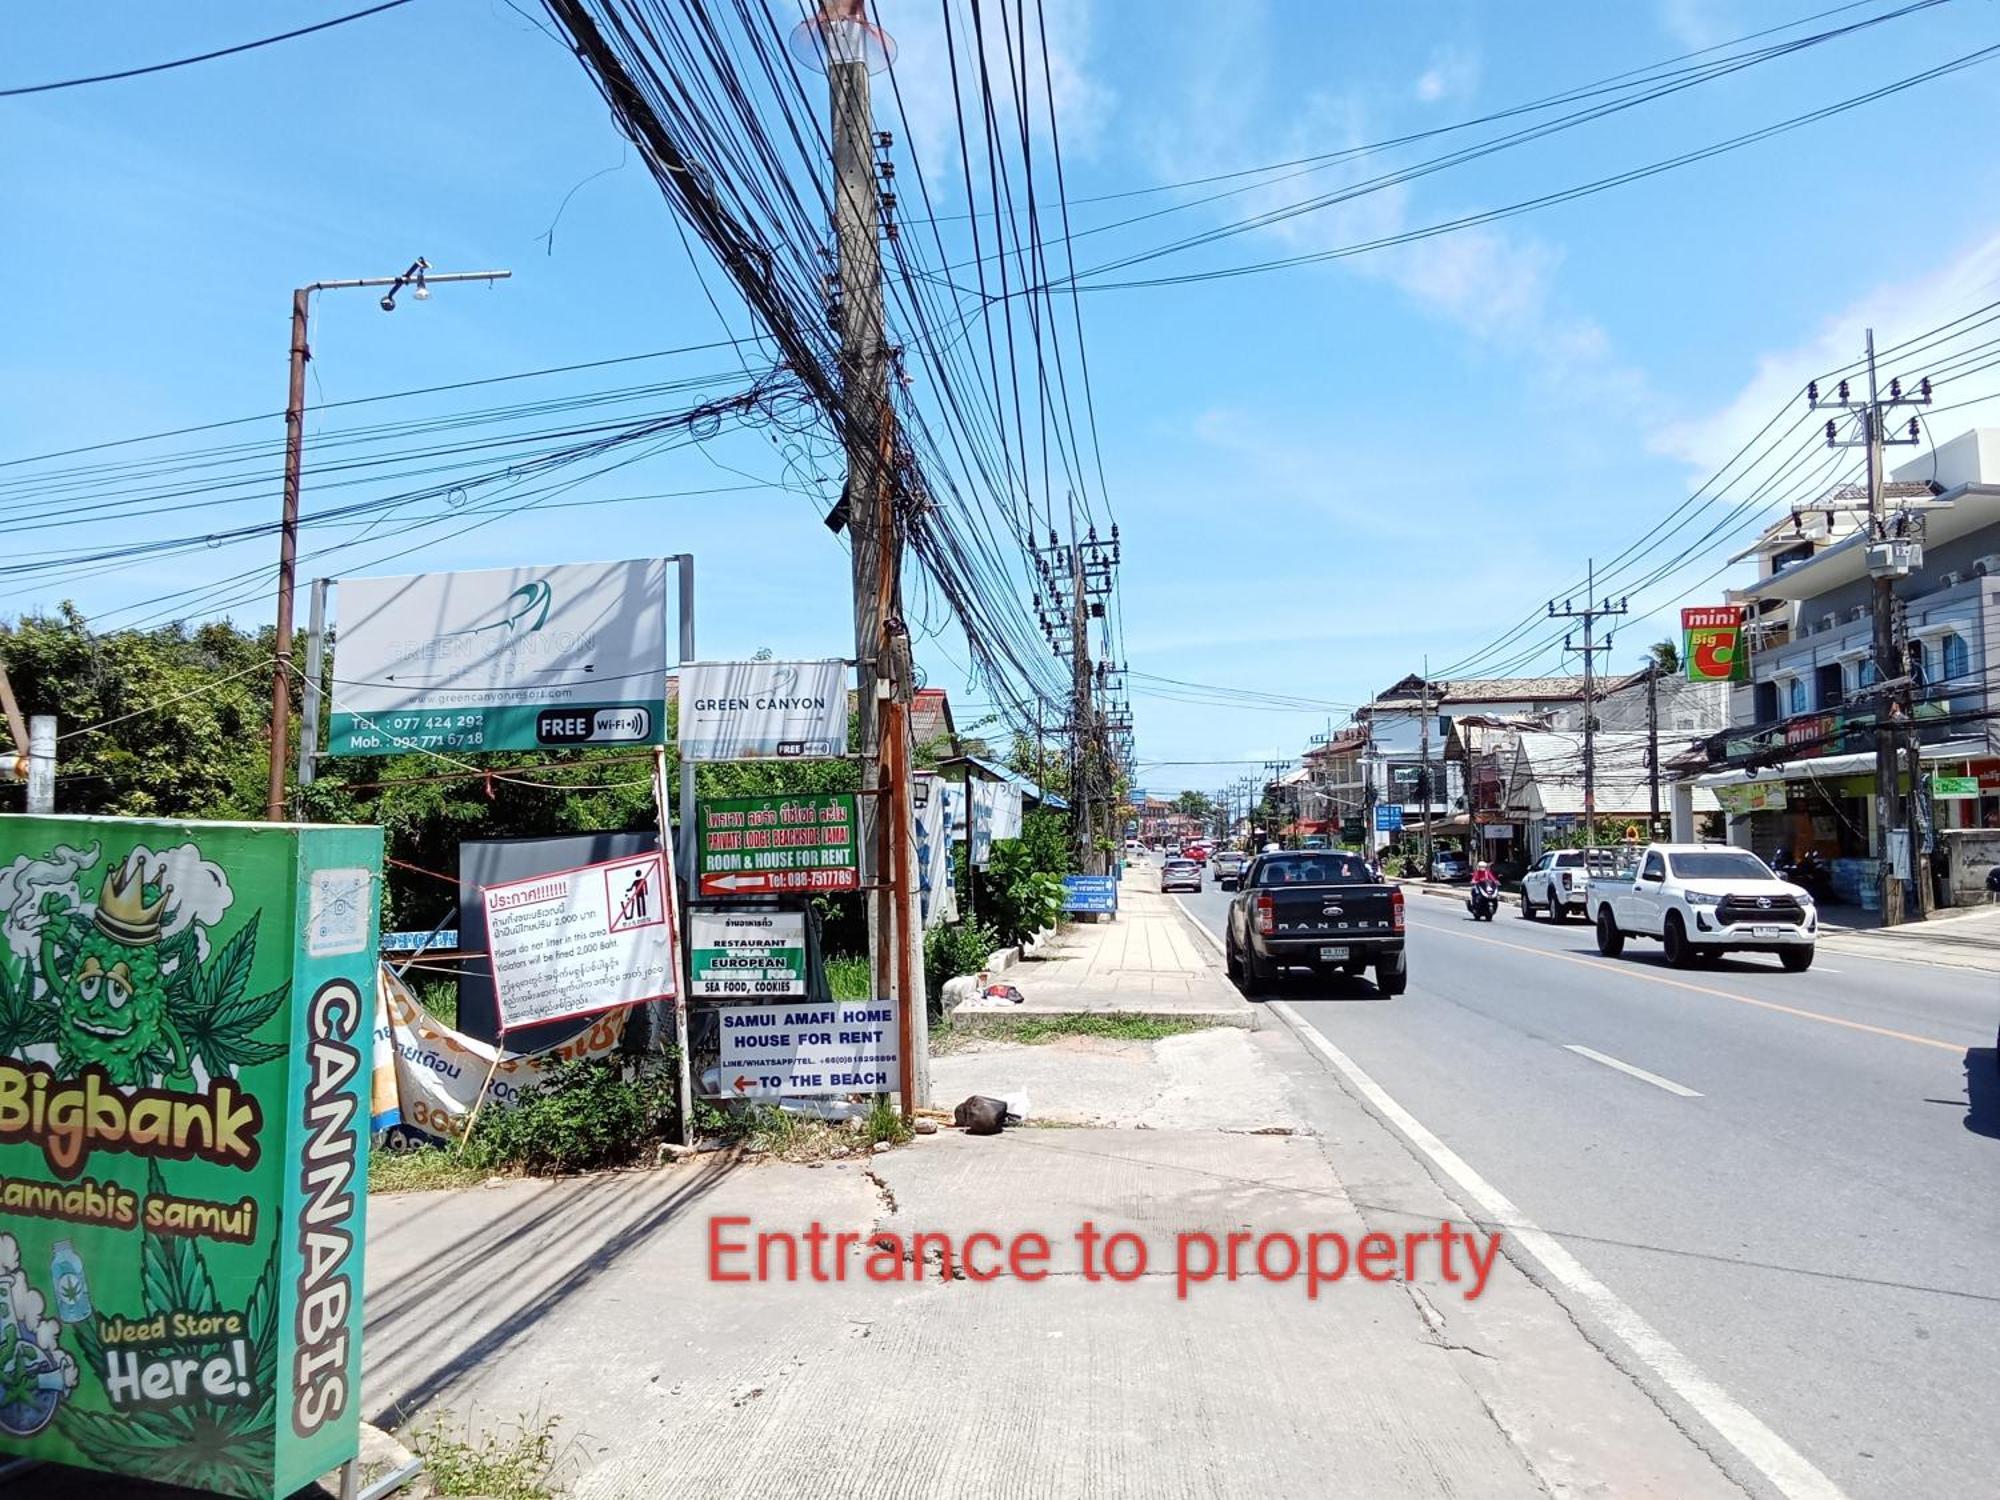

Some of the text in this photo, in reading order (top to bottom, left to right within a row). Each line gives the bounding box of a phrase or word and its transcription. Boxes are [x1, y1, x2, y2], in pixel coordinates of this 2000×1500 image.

[1688, 608, 1735, 625] mini
[1691, 632, 1735, 678] Big C
[695, 697, 825, 711] GREEN CANYON
[394, 717, 420, 730] 077
[425, 716, 452, 730] 424
[456, 715, 483, 728] 292
[541, 718, 625, 737] FREE Wi-Fi
[351, 735, 382, 748] Mob.
[393, 736, 418, 749] 092
[421, 735, 444, 748] 771
[447, 732, 465, 746] 67
[467, 732, 484, 745] 18
[778, 743, 801, 755] FREE
[707, 825, 850, 851] PRIVATE LODGE BEACHSIDE LAMAI
[706, 849, 851, 871] ROOM & HOUSE FOR RENT
[1279, 920, 1389, 930] RANGER
[494, 946, 517, 958] Please
[519, 944, 529, 953] do
[531, 941, 544, 950] not
[545, 937, 563, 948] litter
[574, 932, 588, 942] this
[528, 954, 541, 965] will
[543, 953, 554, 962] be
[555, 948, 574, 960] fined
[576, 943, 598, 955] 2,000
[711, 958, 786, 968] EUROPEAN
[704, 981, 790, 994] SEA FOOD, COOKIES
[723, 1010, 892, 1028] SAMUI AMAFI HOME
[734, 1031, 884, 1048] HOUSE FOR RENT
[722, 1058, 817, 1068] LINE/WHATSAPP/TEL.
[759, 1072, 887, 1088] TO THE BEACH
[0, 1066, 253, 1168] Bigbank
[0, 1183, 253, 1236] annabis samui
[301, 985, 355, 1428] CANNABIS
[101, 1313, 241, 1344] Weed Store
[106, 1339, 251, 1403] Here!
